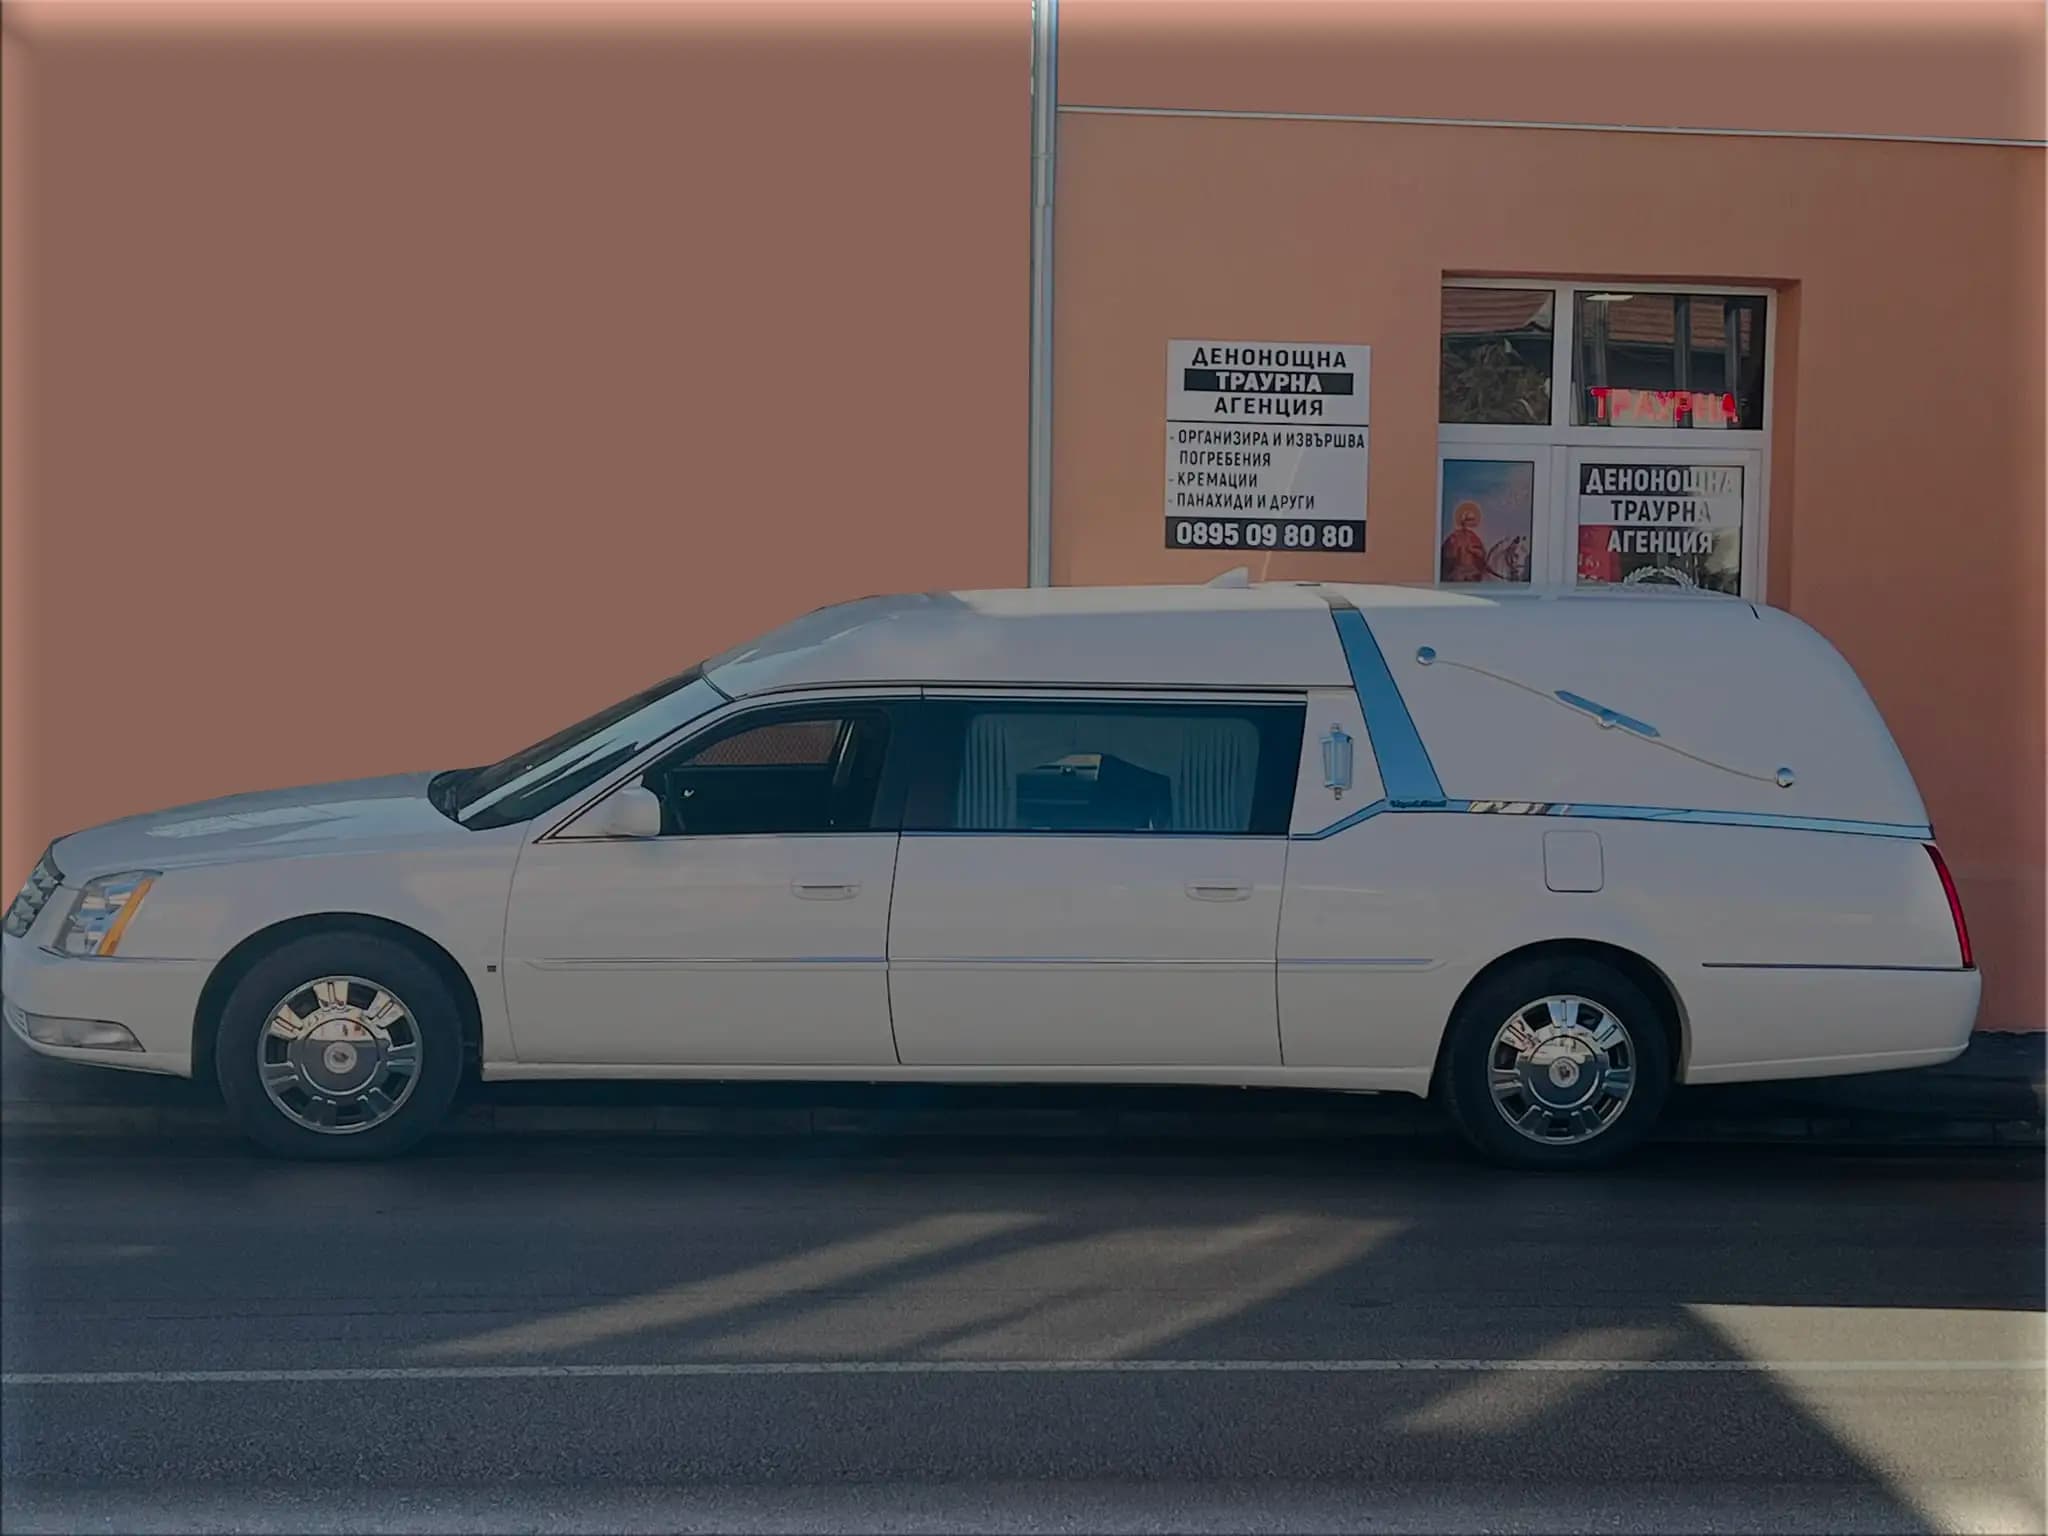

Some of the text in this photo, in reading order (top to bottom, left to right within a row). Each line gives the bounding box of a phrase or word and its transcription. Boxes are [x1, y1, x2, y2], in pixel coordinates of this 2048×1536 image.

[1191, 347, 1346, 369] ДЕНОНОЩНА
[1215, 371, 1322, 393] ТРАУРНА
[1214, 397, 1323, 418] АГЕНЦИЯ
[1178, 429, 1365, 449] ОРГАНИЗИРА И ИЗВЪРШВА
[1179, 450, 1271, 466] ПОГРЕБЕНИЯ
[1177, 471, 1258, 489] КРЕМАЦИИ
[1176, 492, 1315, 510] ПАНАХИДИ И ДРУГИ
[1610, 500, 1711, 523] ТРАУРНА
[1176, 521, 1354, 548] 0895 09 80 80
[1607, 530, 1713, 557] АГЕНЦИЯ
